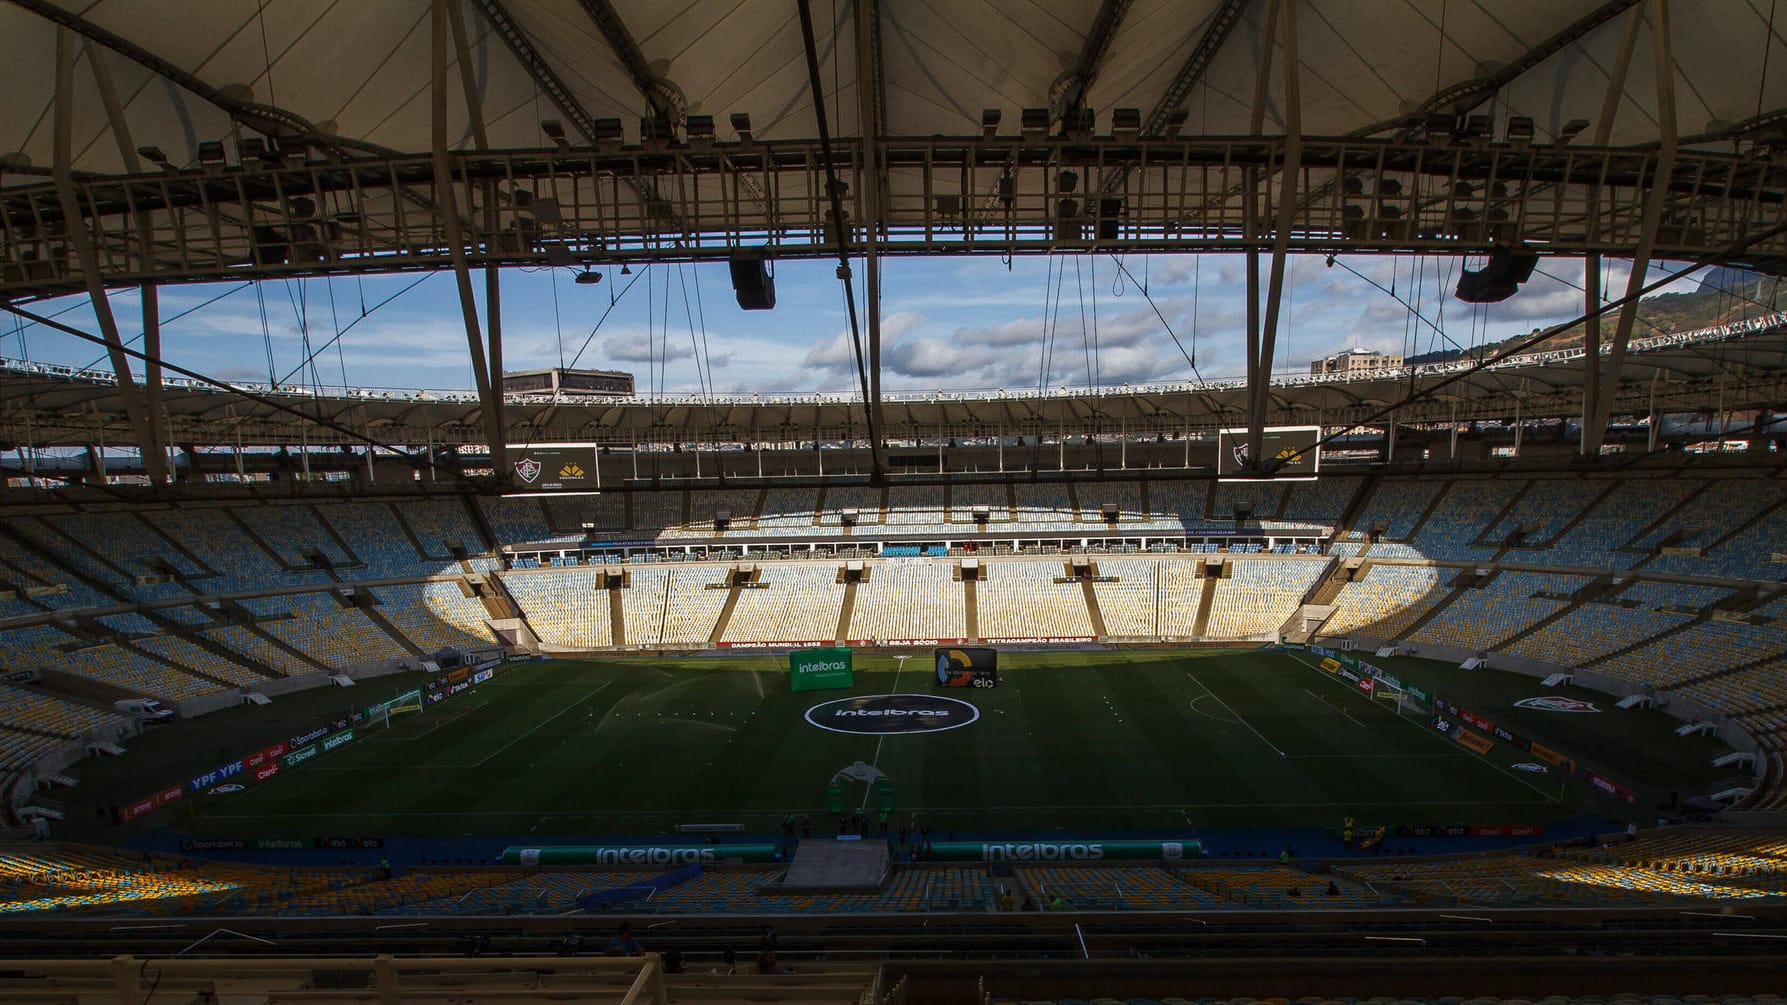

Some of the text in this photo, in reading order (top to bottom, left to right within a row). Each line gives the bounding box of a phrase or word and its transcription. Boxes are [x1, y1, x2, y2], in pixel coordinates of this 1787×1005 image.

[973, 677, 994, 688] elo
[219, 761, 243, 778] YPF
[192, 772, 217, 790] YPF
